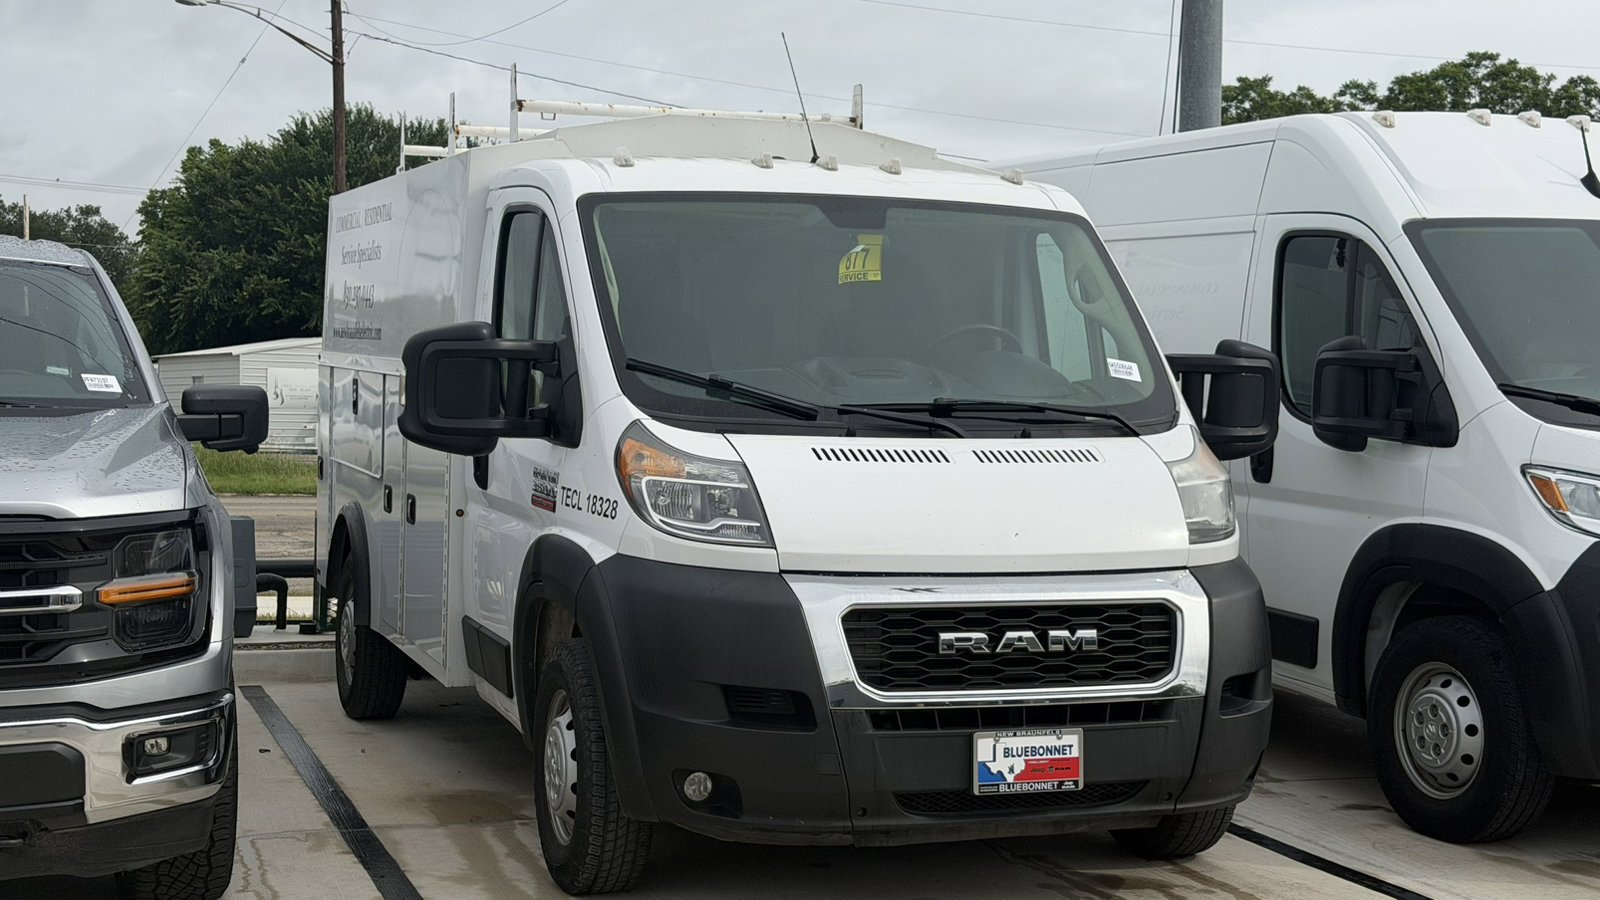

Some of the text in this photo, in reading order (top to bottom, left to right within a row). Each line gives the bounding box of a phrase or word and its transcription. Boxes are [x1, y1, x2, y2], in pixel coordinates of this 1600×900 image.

[336, 202, 392, 233] COMMERCIAL RESIDENTIAL
[341, 240, 382, 269] Service Specialists
[840, 272, 869, 281] SERVICE
[561, 486, 583, 511] TECL
[586, 493, 619, 520] 18328
[938, 629, 1098, 654] RAM
[1003, 744, 1074, 758] BLUEBONNET
[999, 782, 1059, 792] BLUEBONNET
